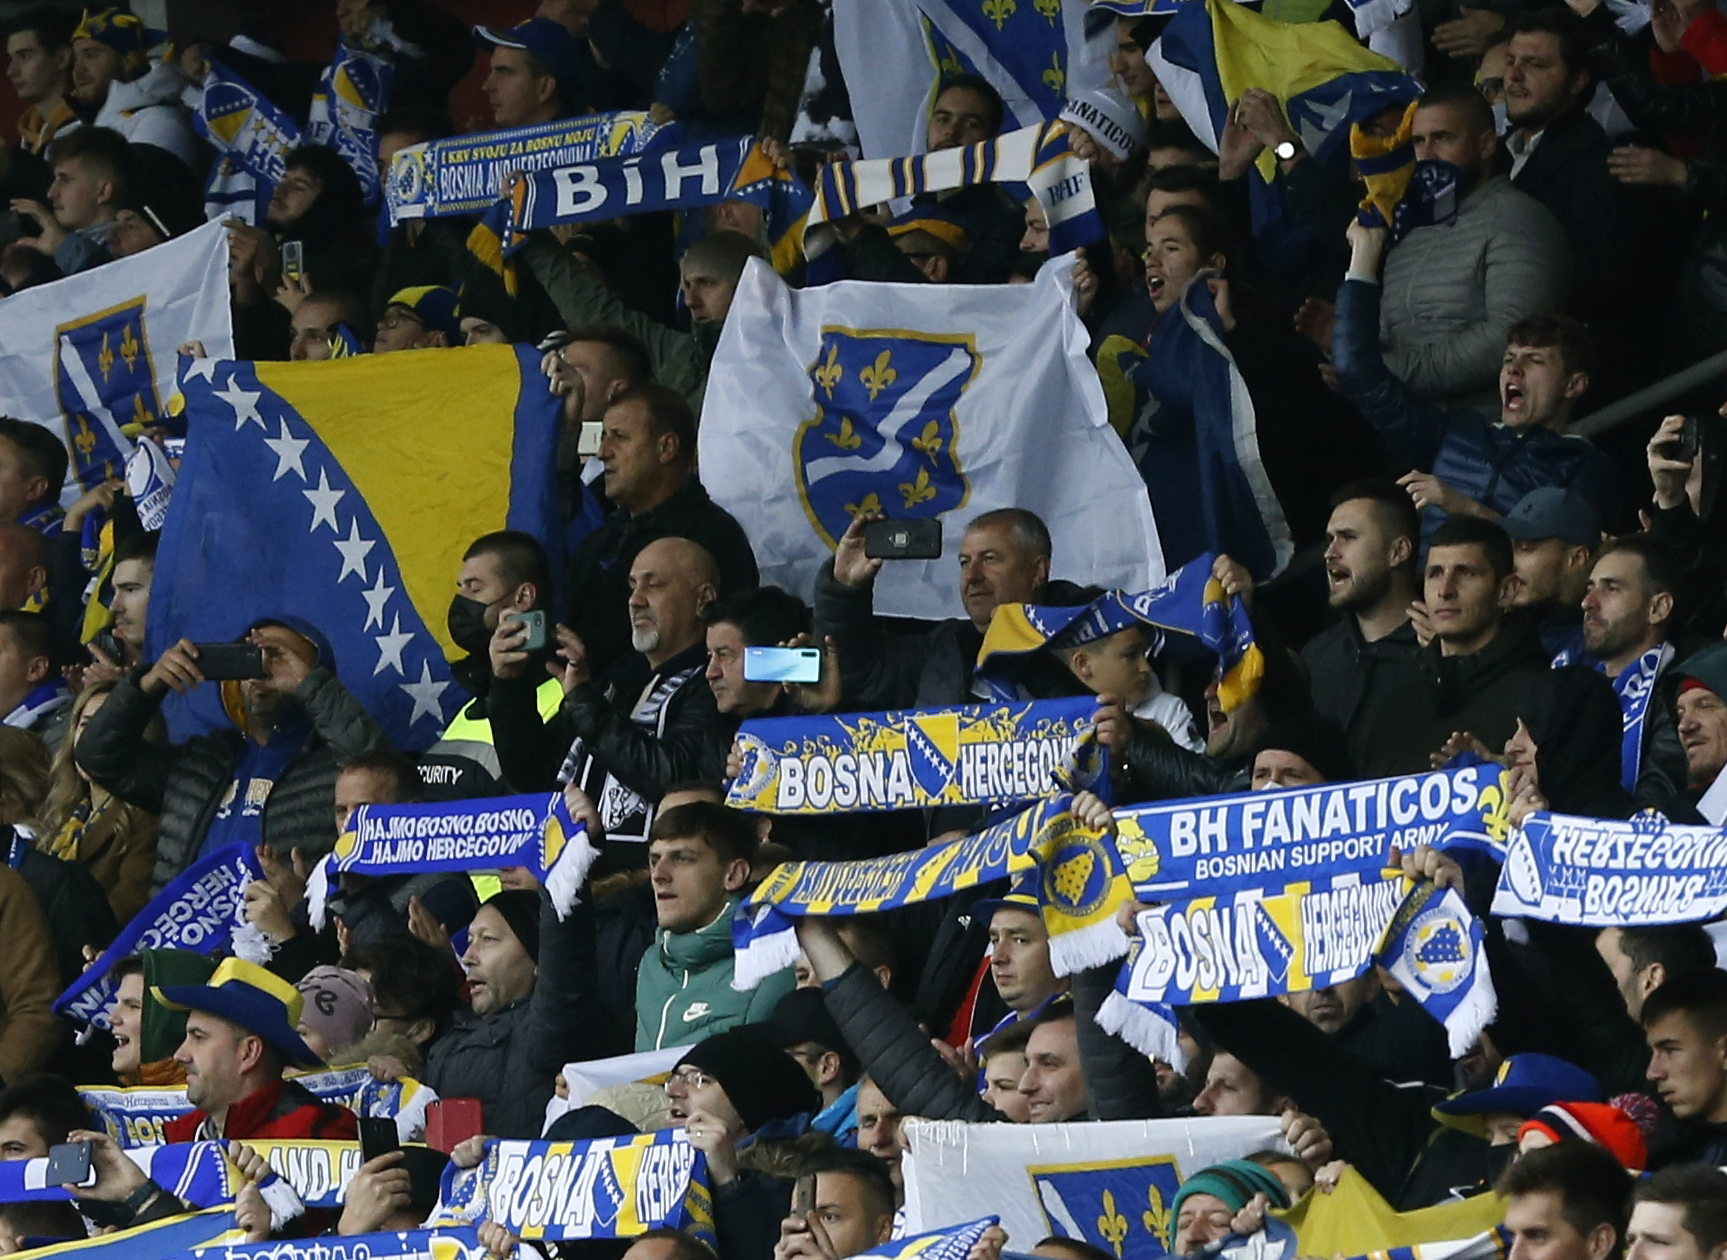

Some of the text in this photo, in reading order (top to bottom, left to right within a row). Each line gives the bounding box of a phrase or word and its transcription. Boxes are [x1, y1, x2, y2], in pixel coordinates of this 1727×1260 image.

[440, 162, 487, 200] BOSNIA
[552, 143, 720, 217] BiH
[415, 763, 465, 785] CURITY
[774, 750, 915, 810] BOSNA
[364, 816, 414, 842] HAJMO
[1168, 766, 1481, 862] BH FANATICOS
[1194, 821, 1452, 881] BOSNIAN SUPPORT ARMY
[1142, 896, 1260, 991] BOSNA
[492, 1152, 595, 1229] BOSNA
